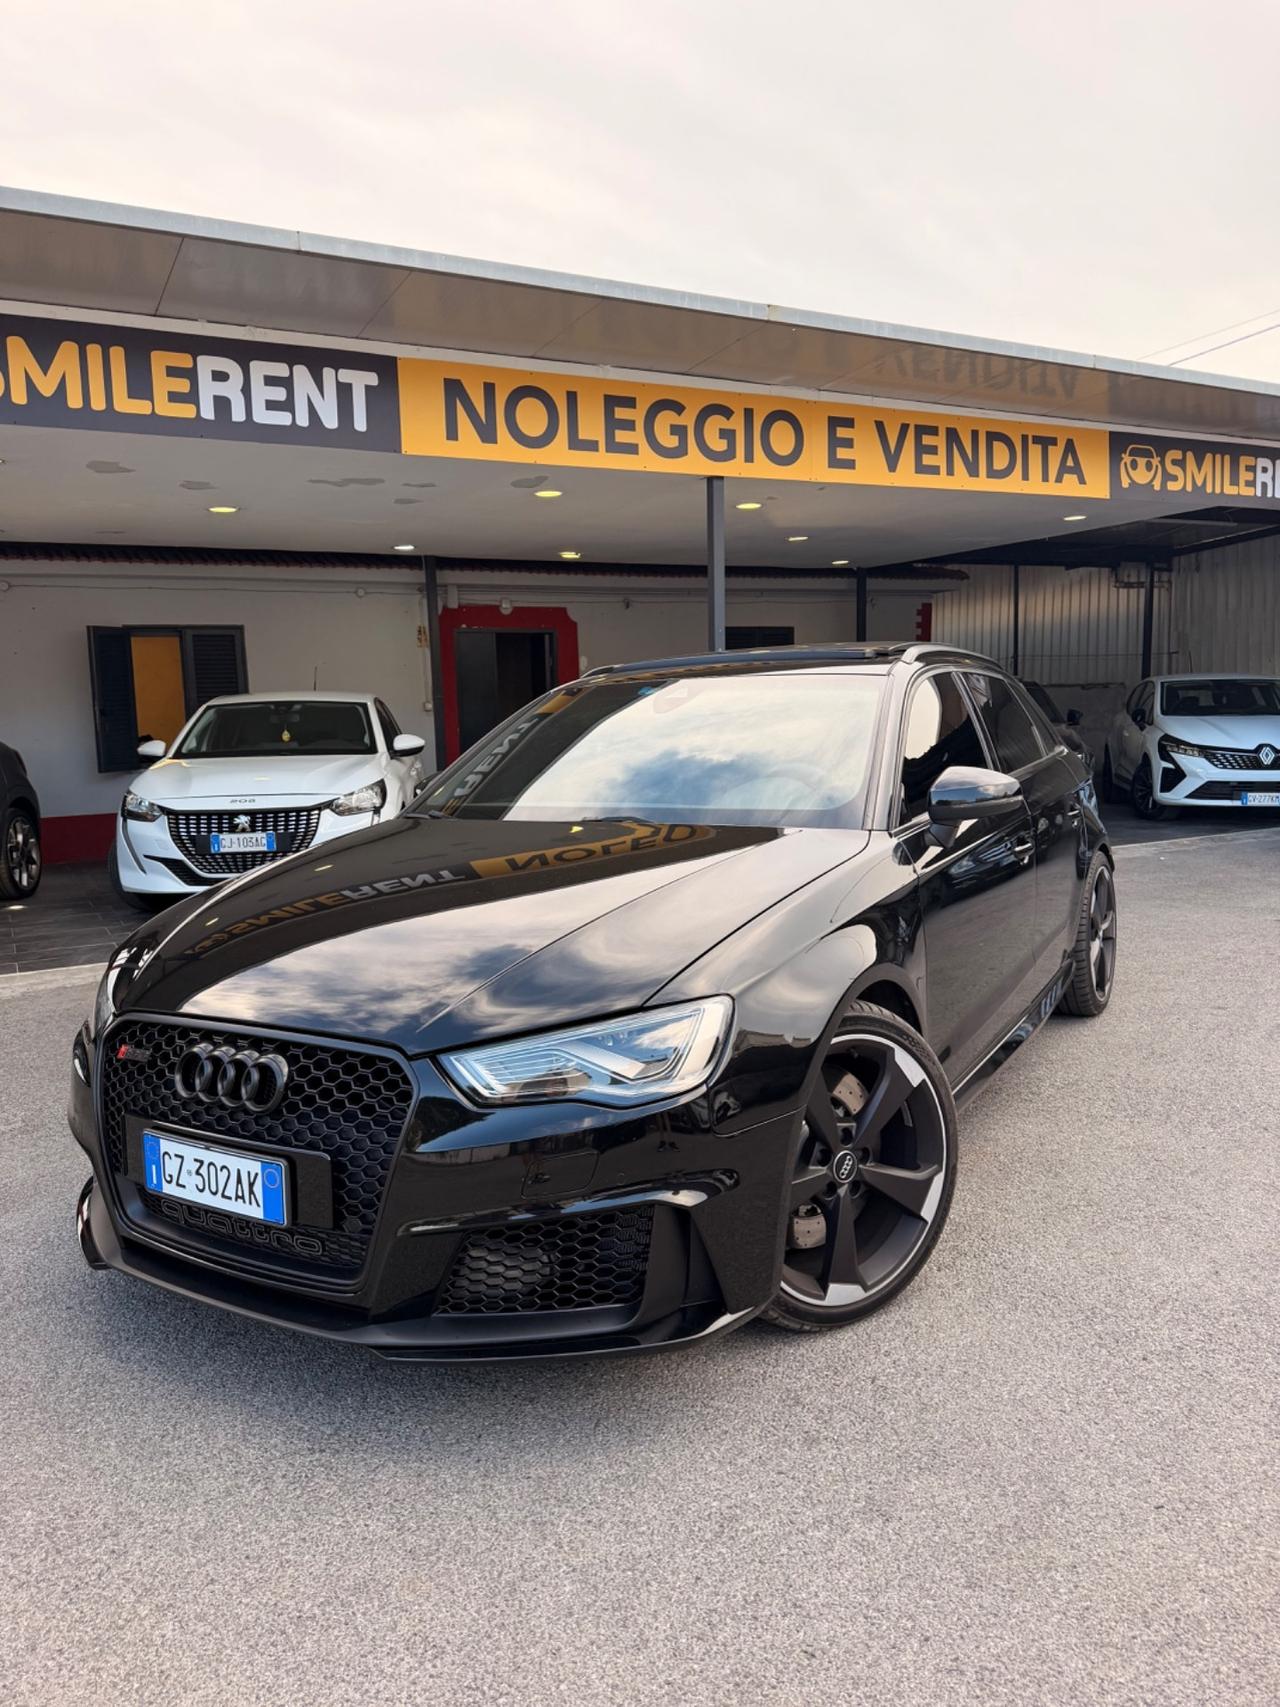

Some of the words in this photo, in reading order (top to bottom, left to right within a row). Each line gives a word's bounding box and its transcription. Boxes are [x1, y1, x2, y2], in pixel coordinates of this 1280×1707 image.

[0, 335, 378, 432] MILERENT
[443, 377, 805, 466] NOLEGGIO
[827, 415, 856, 470] E
[874, 420, 1087, 485] VENDITA
[162, 1151, 186, 1189] GZ
[193, 1158, 261, 1208] 302AK
[161, 1199, 322, 1256] quattro
